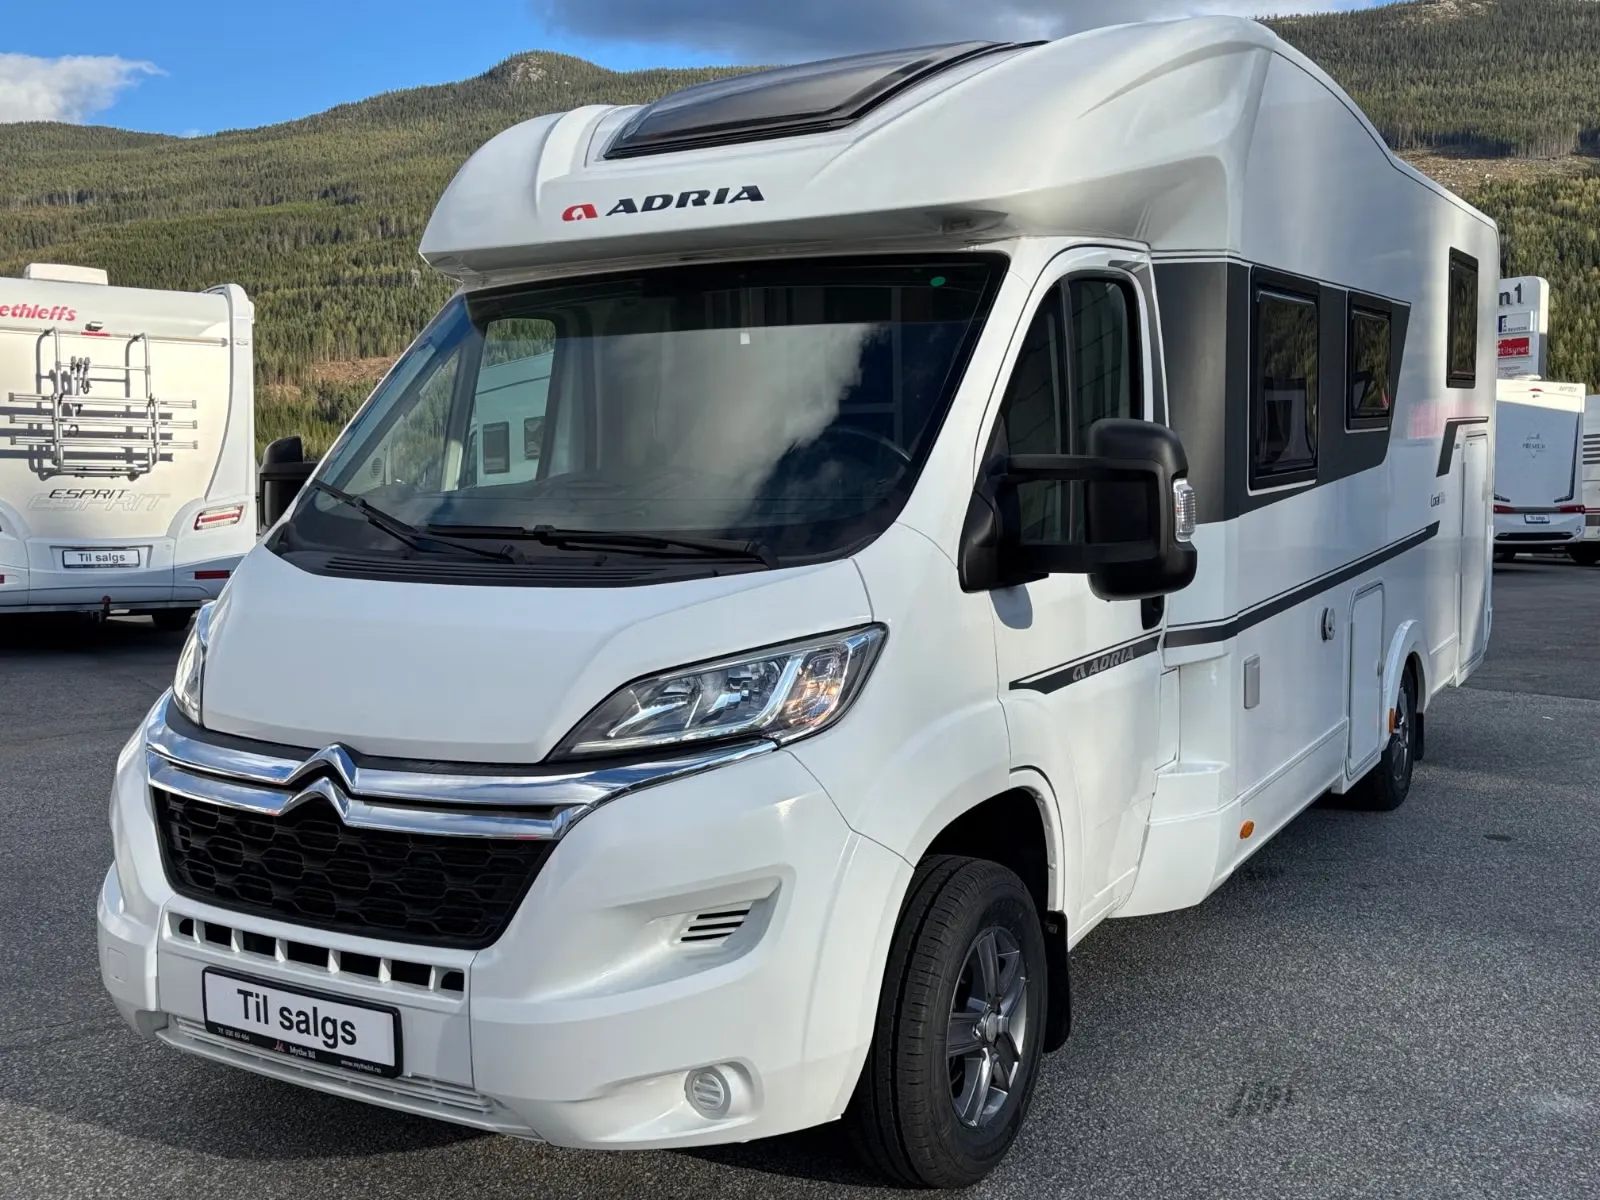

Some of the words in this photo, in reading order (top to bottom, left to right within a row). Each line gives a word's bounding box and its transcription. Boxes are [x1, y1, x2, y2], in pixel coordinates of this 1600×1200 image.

[605, 185, 765, 217] ADRIA
[1514, 283, 1522, 304] 1
[0, 304, 77, 321] ethleffs
[27, 493, 170, 511] ESPRIT
[49, 489, 130, 499] ESPRIT
[78, 552, 91, 562] Til
[95, 552, 126, 564] salgs
[1088, 647, 1134, 676] ADRIA
[237, 988, 269, 1025] Til
[279, 1006, 357, 1049] salgs
